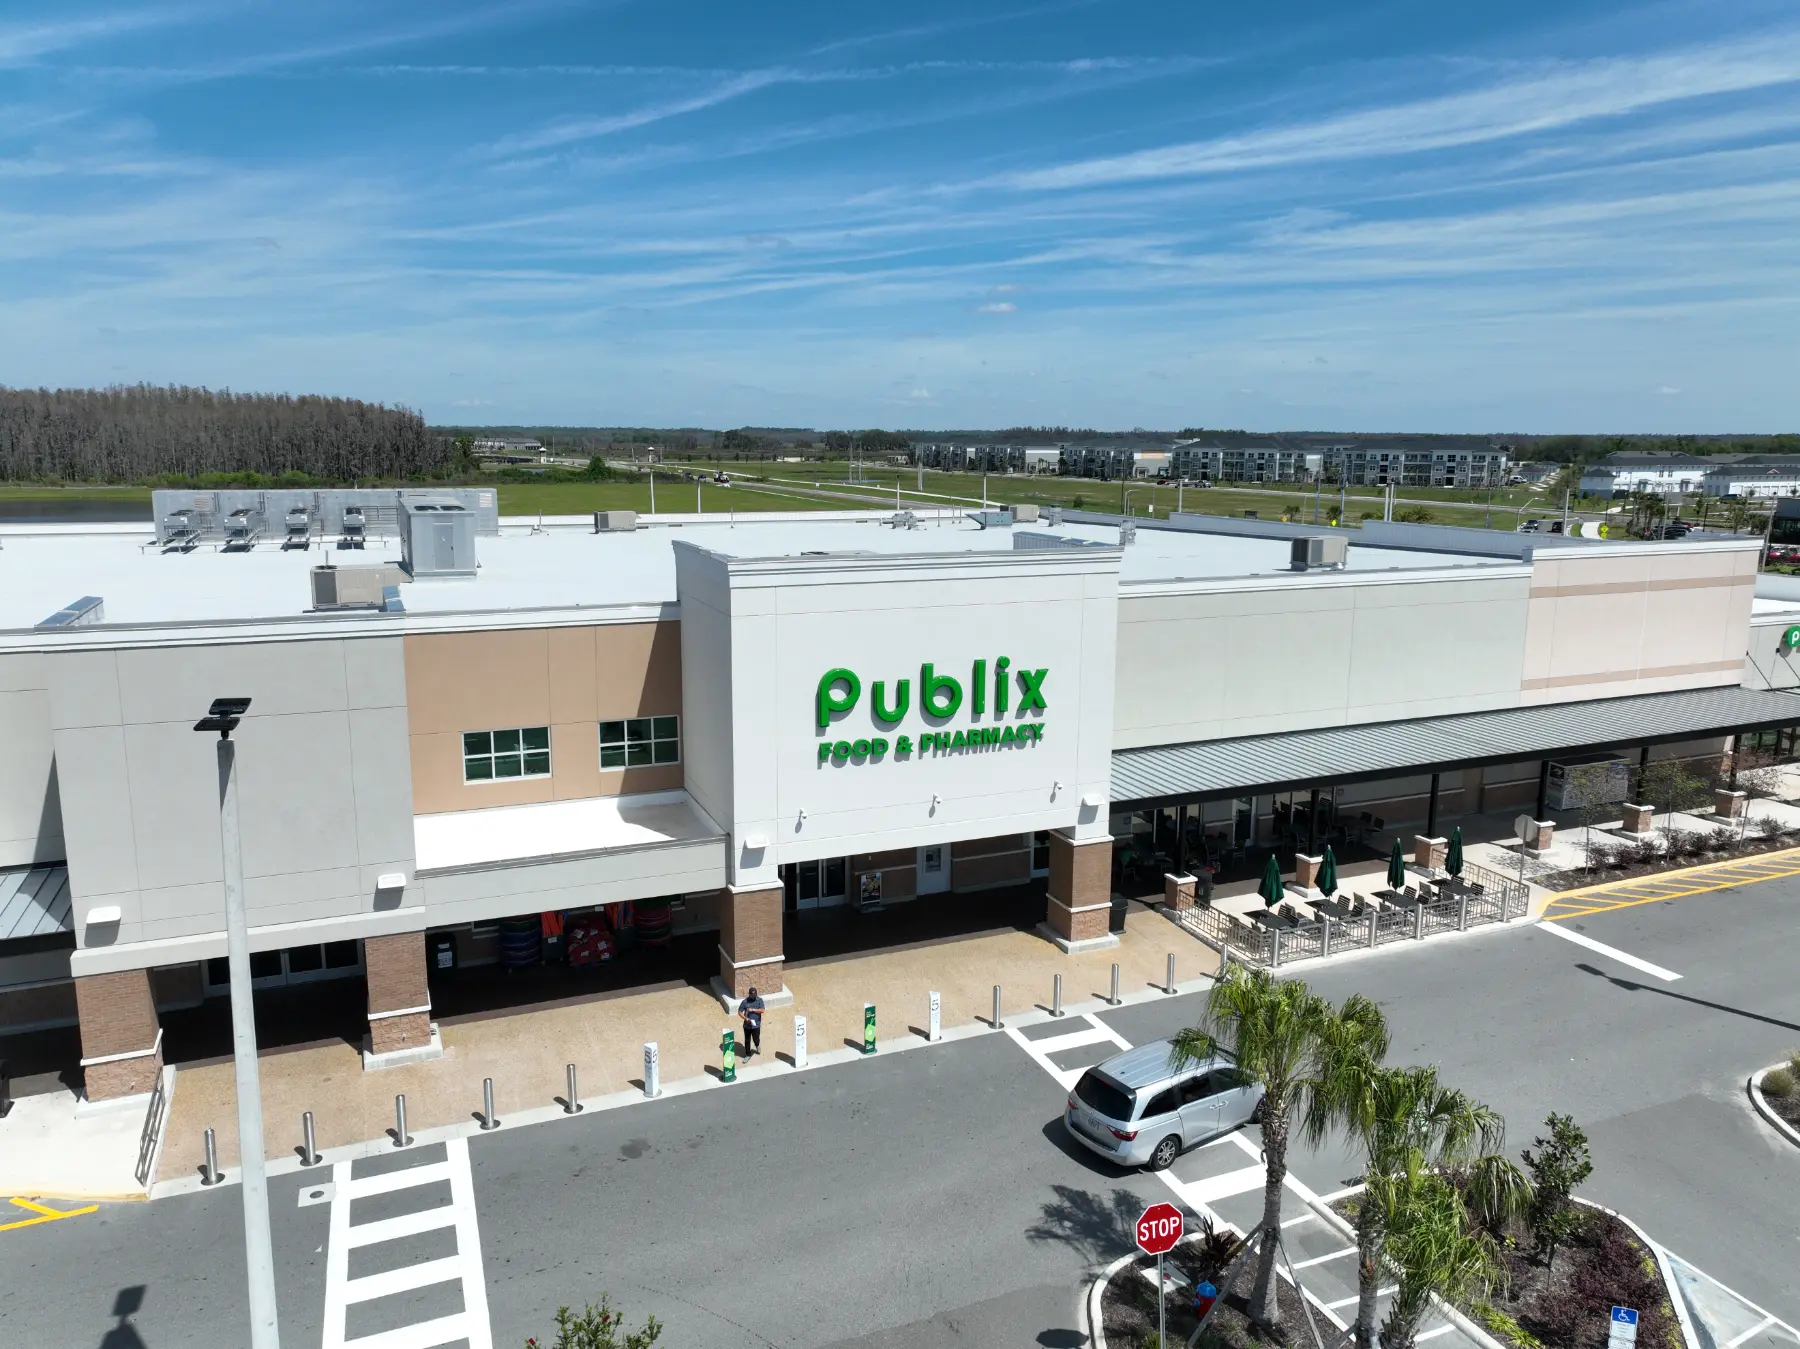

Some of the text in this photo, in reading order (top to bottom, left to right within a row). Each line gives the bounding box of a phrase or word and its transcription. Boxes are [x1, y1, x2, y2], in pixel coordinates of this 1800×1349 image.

[817, 655, 1049, 728] Publix
[819, 722, 1046, 761] FOOD & PHARMACY
[1140, 1216, 1180, 1241] STOP
